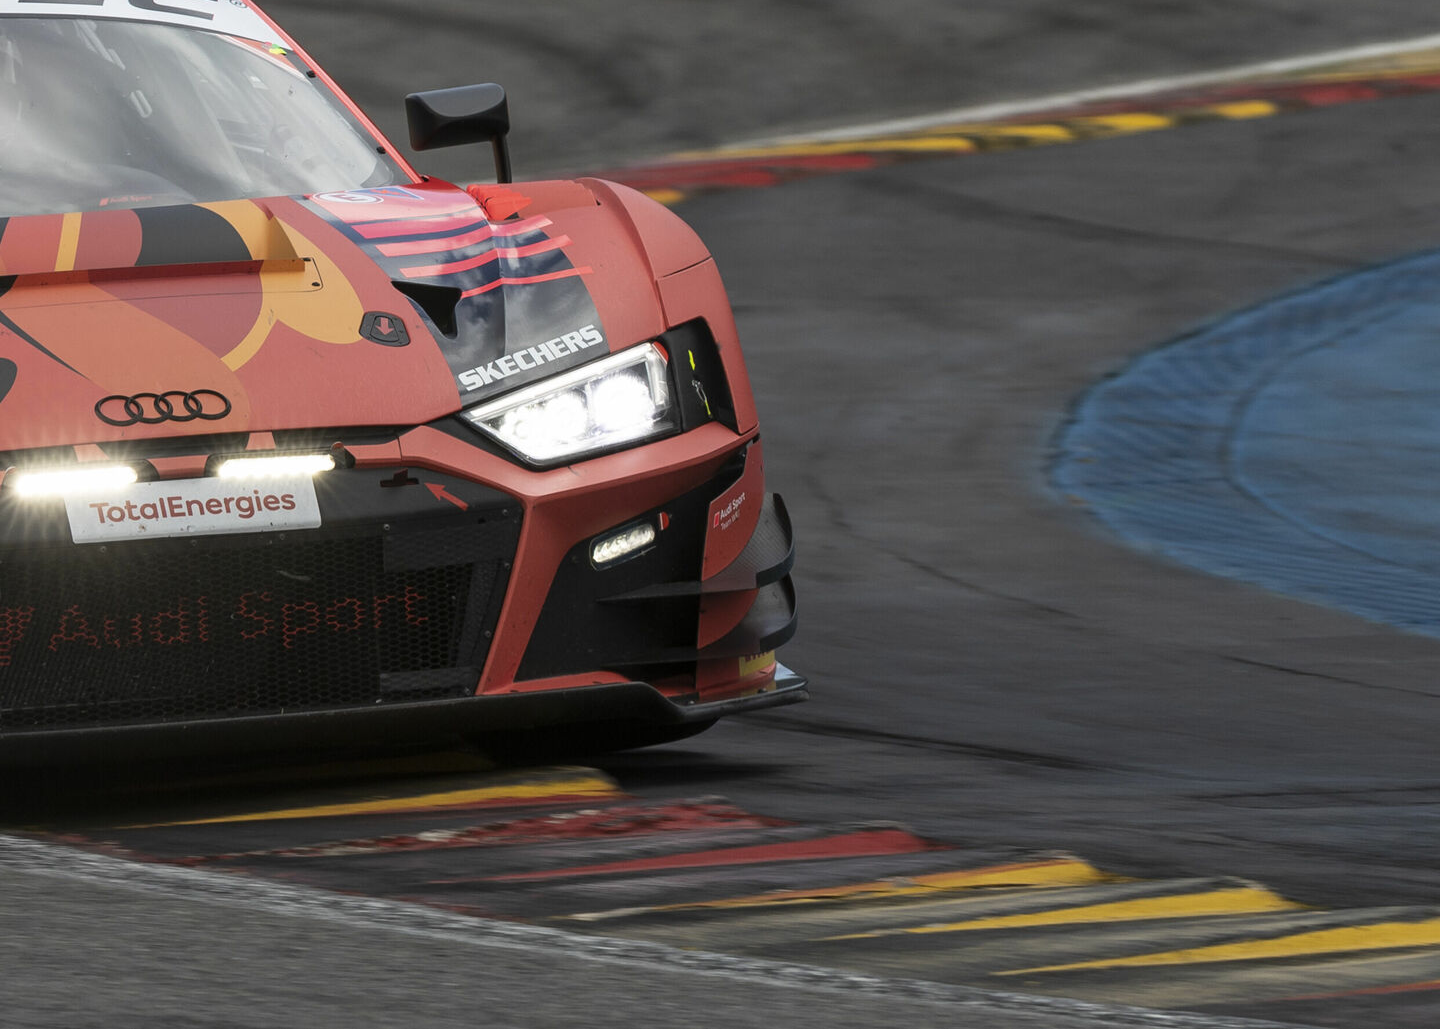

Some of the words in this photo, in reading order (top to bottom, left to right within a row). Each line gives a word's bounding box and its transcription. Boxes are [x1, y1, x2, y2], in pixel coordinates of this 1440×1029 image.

[458, 324, 604, 392] SKECHERS
[89, 489, 296, 524] TotalEnergies
[48, 595, 209, 652] Audi
[237, 586, 429, 649] Sport
